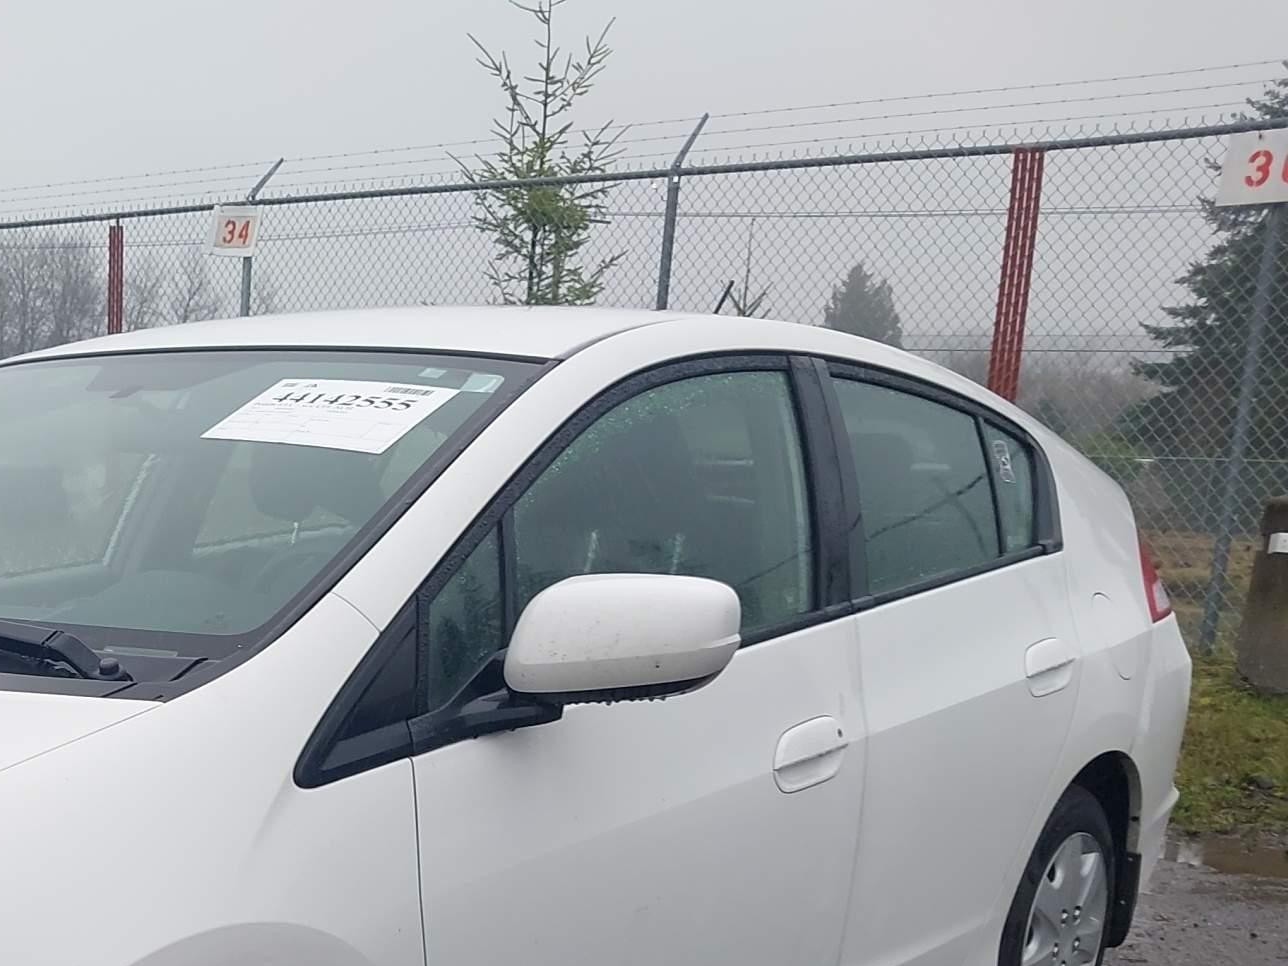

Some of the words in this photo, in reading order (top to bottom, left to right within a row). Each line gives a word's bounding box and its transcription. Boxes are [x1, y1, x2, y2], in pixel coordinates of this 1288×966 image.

[1245, 149, 1288, 187] 3
[223, 219, 250, 245] 34
[272, 391, 418, 412] 44142555
